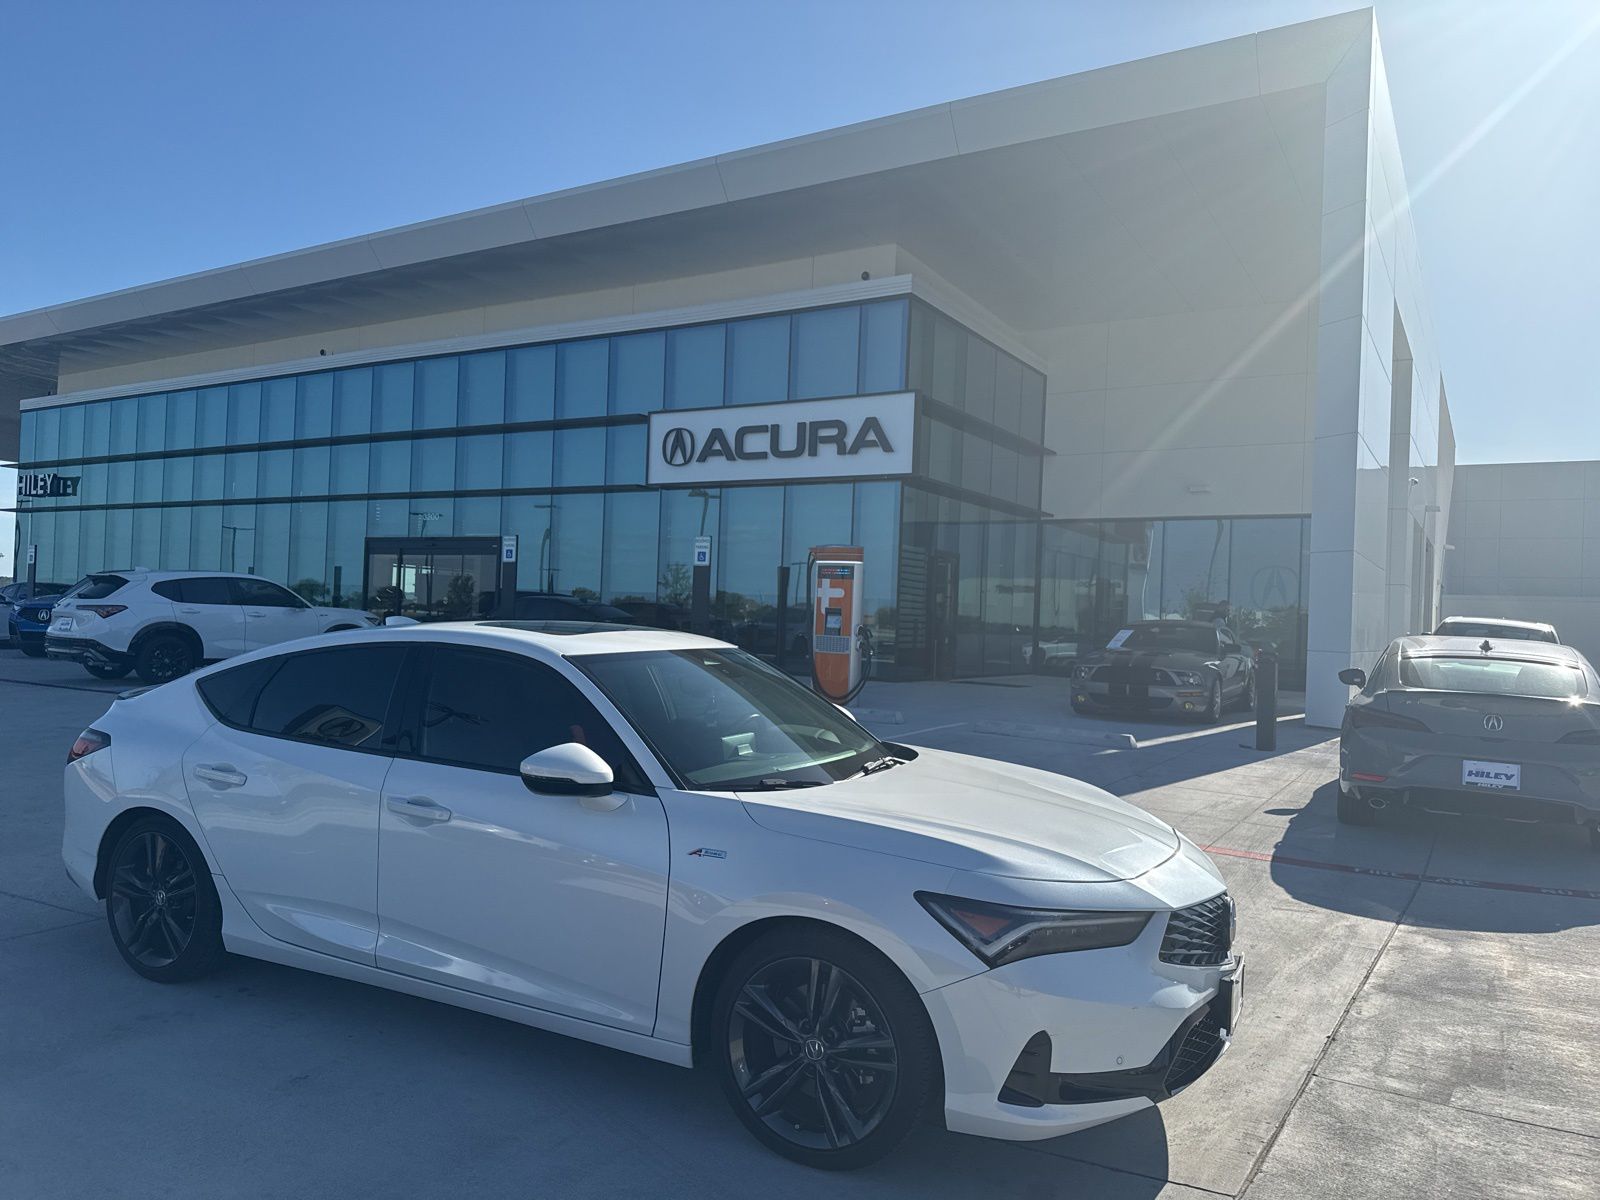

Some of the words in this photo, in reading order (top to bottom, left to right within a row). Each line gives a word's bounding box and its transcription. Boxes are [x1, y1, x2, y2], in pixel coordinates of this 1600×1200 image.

[696, 416, 894, 463] ACURA
[18, 473, 54, 495] HILEY
[1467, 769, 1515, 781] HILEY
